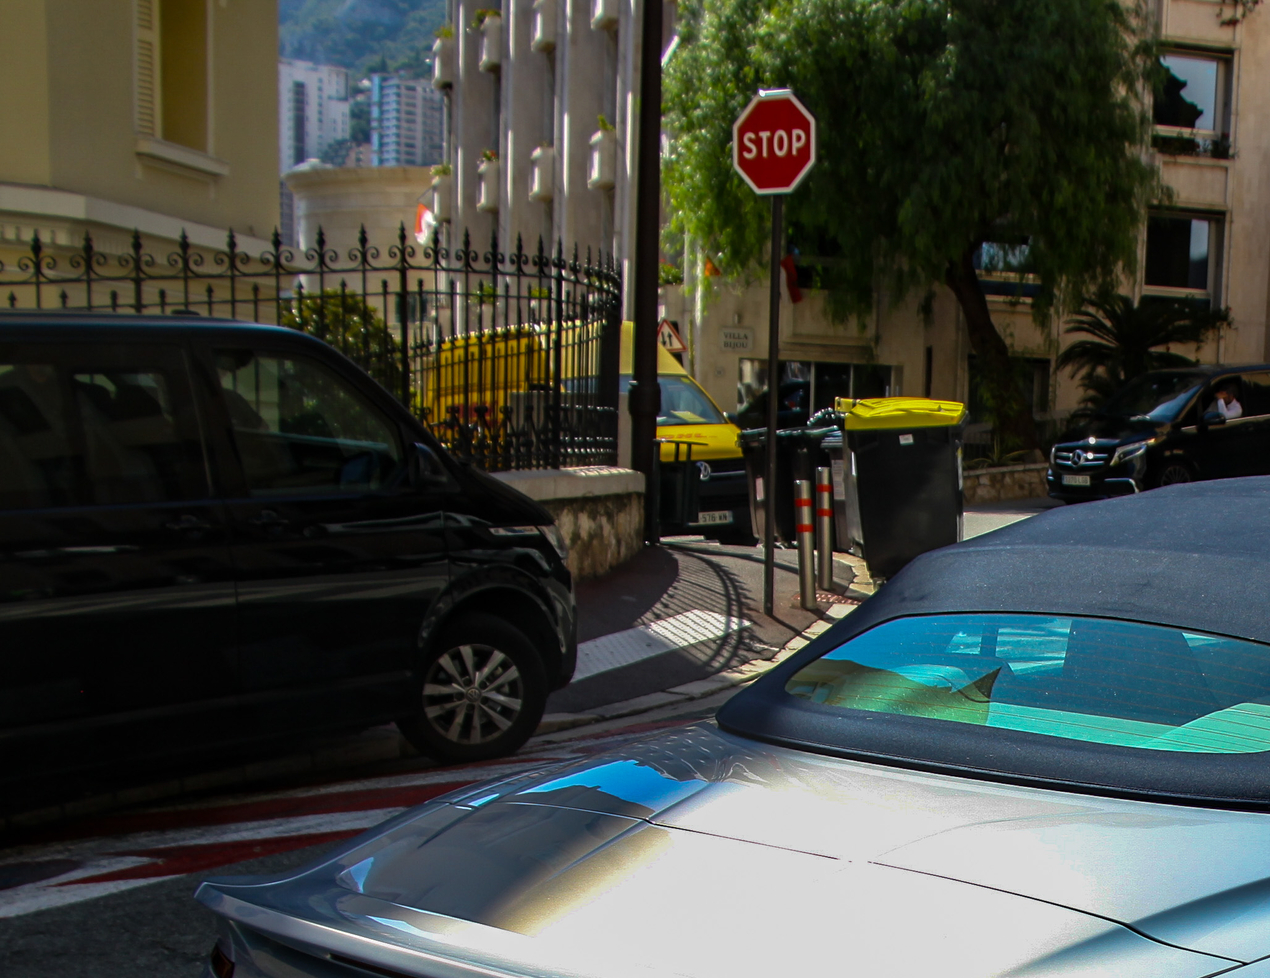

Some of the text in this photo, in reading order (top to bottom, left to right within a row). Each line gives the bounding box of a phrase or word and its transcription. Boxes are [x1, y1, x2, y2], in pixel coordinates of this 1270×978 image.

[742, 128, 806, 160] STOP
[723, 332, 748, 340] VILLA
[723, 341, 748, 349] BIJOU
